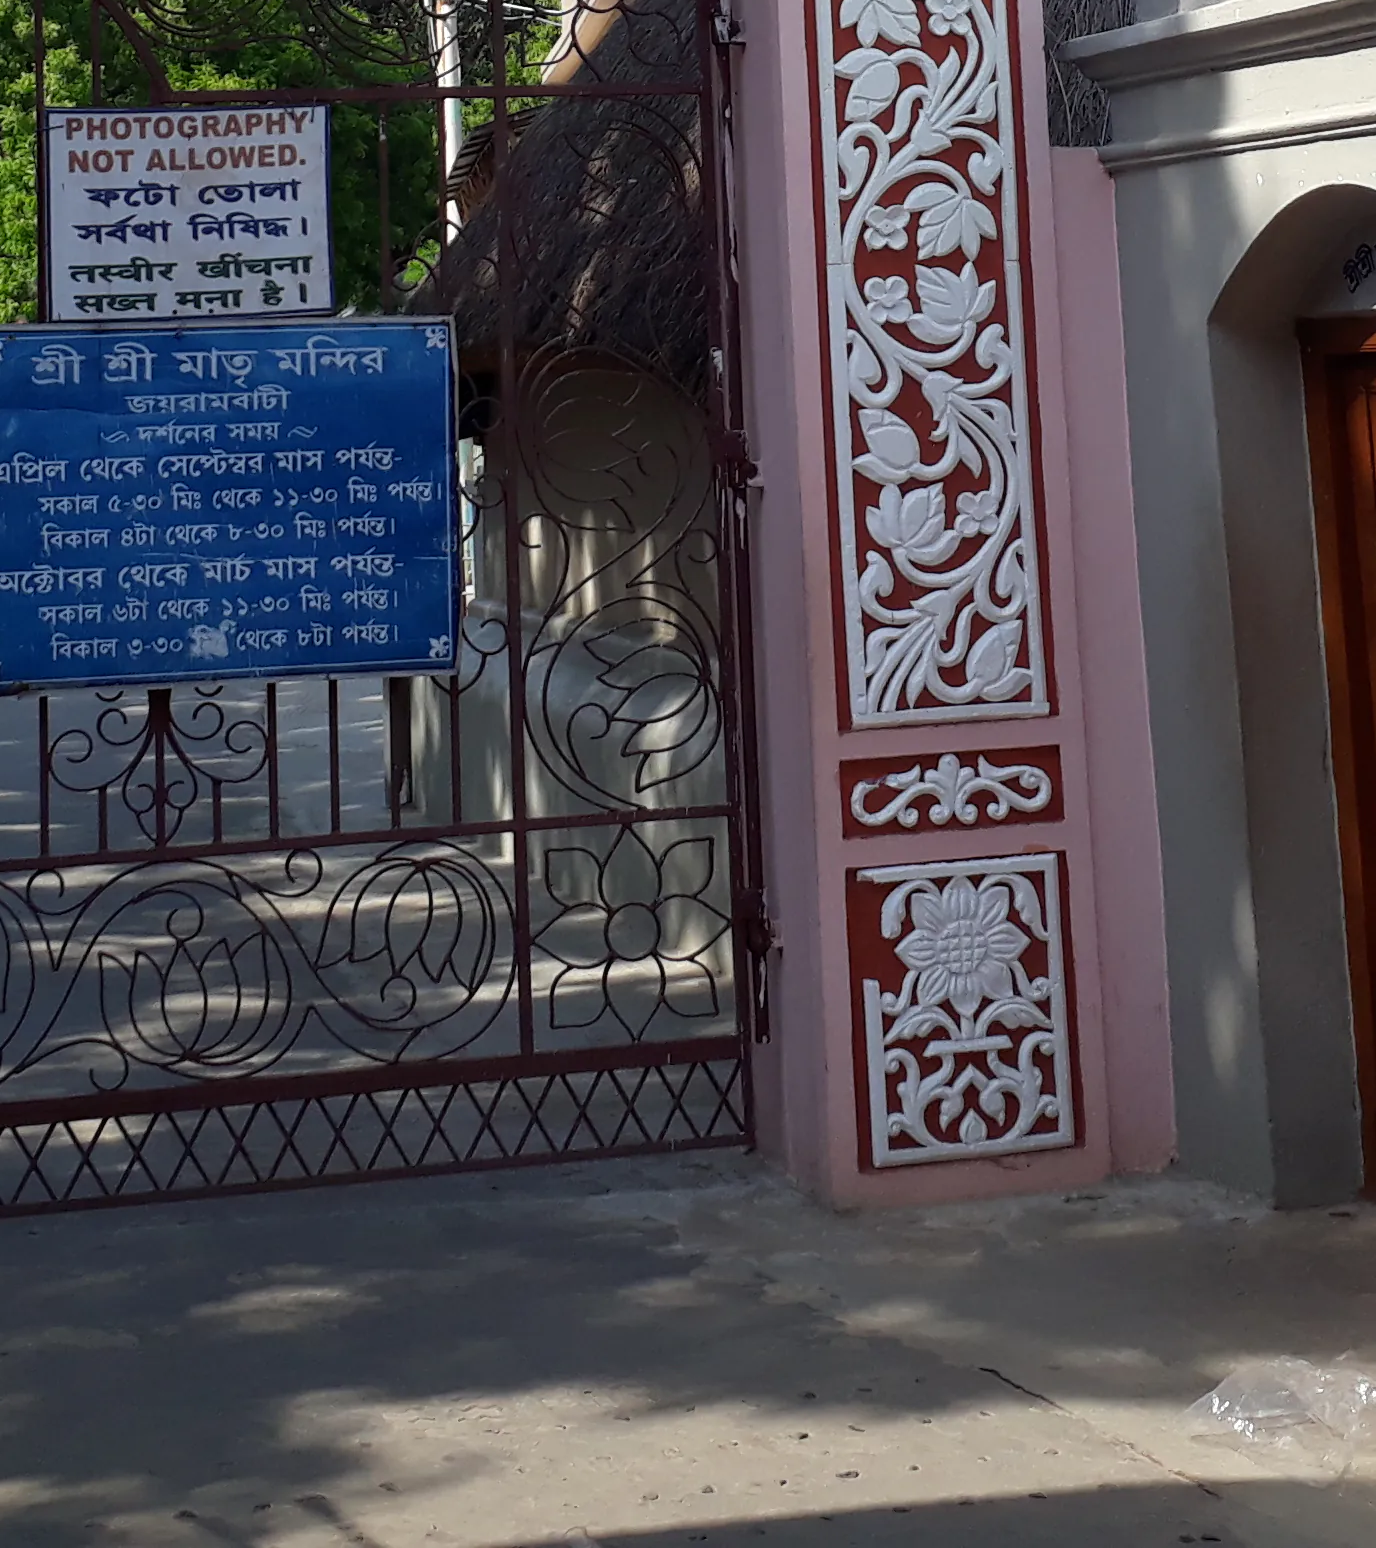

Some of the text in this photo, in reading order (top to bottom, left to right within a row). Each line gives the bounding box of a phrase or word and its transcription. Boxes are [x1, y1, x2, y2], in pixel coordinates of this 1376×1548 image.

[65, 110, 309, 141] PHOTOGRAPHY
[68, 143, 306, 173] NOT ALLOWED.
[83, 178, 302, 208] ফটো তোলা
[72, 213, 172, 244] সর্বথা
[68, 252, 312, 283] तस्वीर खींचना
[73, 292, 157, 314] सख्त
[175, 288, 243, 310] मना
[30, 334, 389, 388] শ্রী শ্রী মাতৃ মন্দির
[125, 383, 292, 415] জয়রামবাটী
[135, 417, 282, 444] দর্শনের সময়
[80, 455, 146, 482] থেকে
[158, 448, 265, 479] সেপ্টেম্বর
[274, 450, 326, 473] মাস
[38, 494, 99, 516] সকাল
[212, 487, 263, 510] থেকে
[42, 523, 112, 550] বিকাল
[120, 521, 156, 547] ৪টা
[165, 524, 220, 546] থেকে
[118, 562, 192, 589] থেকে
[202, 553, 256, 583] মার্চ
[262, 556, 319, 579] মাস
[38, 604, 103, 626] সকাল
[112, 597, 148, 621] ৬টা
[158, 597, 211, 619] থেকে
[51, 632, 119, 661] বিকাল
[236, 629, 289, 651] থেকে
[297, 622, 333, 646] ৮টা
